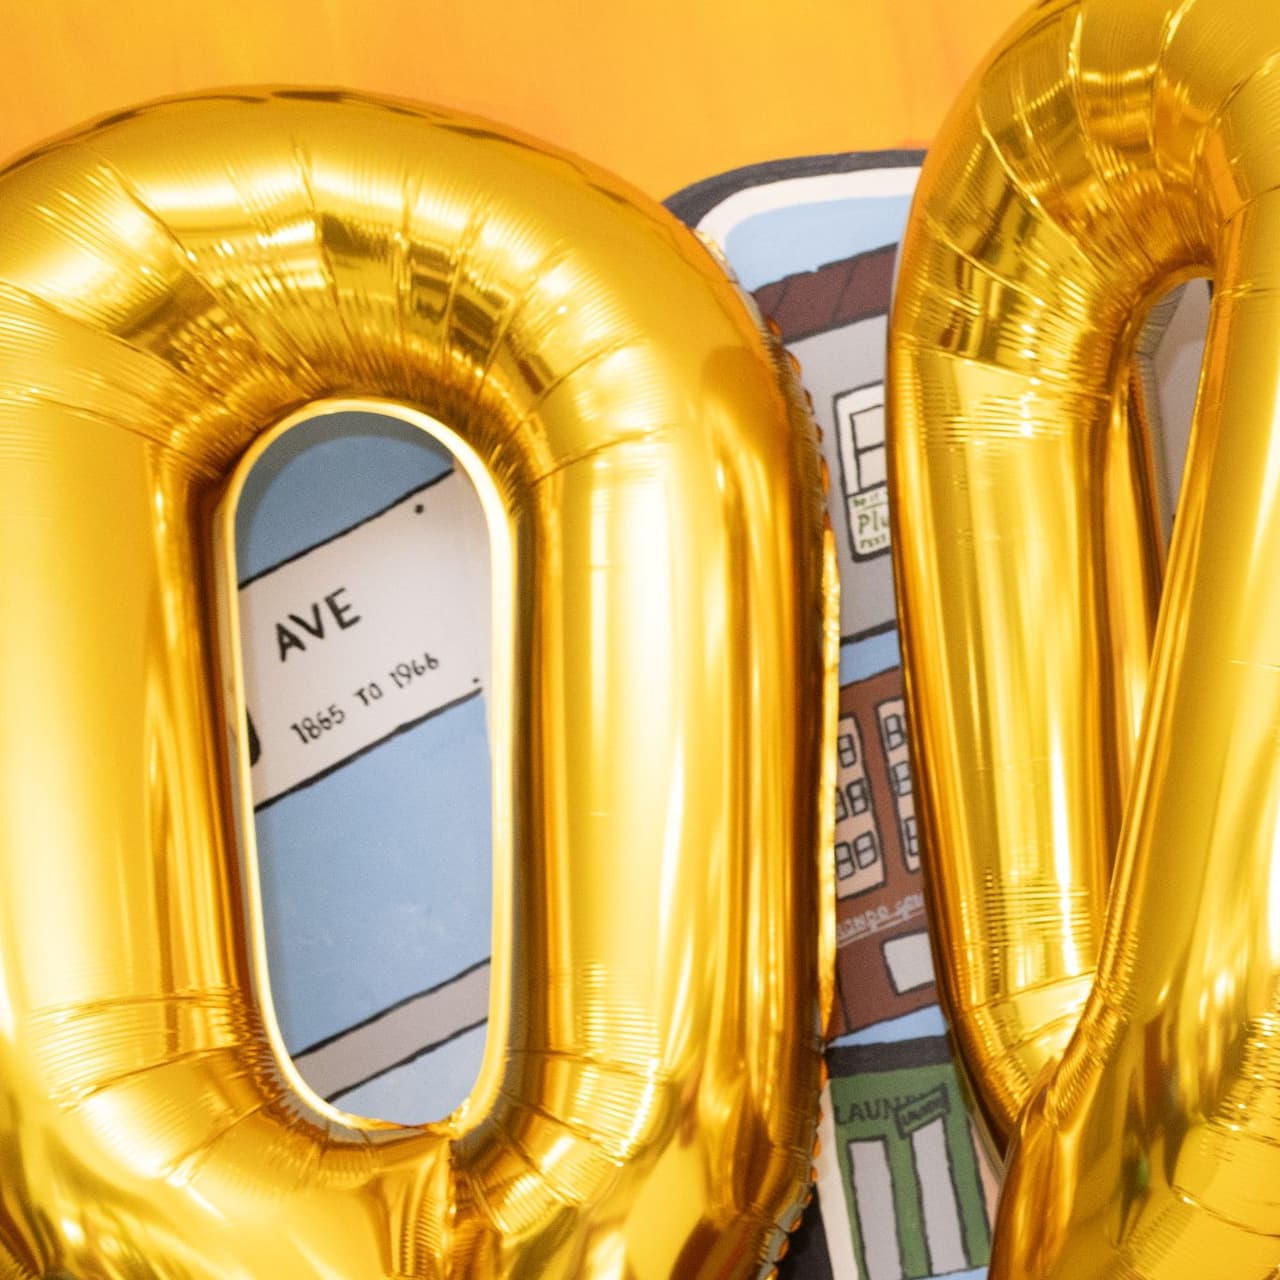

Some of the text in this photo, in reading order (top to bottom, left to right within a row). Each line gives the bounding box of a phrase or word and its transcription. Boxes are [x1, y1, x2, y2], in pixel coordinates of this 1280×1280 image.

[275, 588, 361, 662] AVE
[289, 703, 346, 744] 1865
[388, 652, 440, 689] 1966
